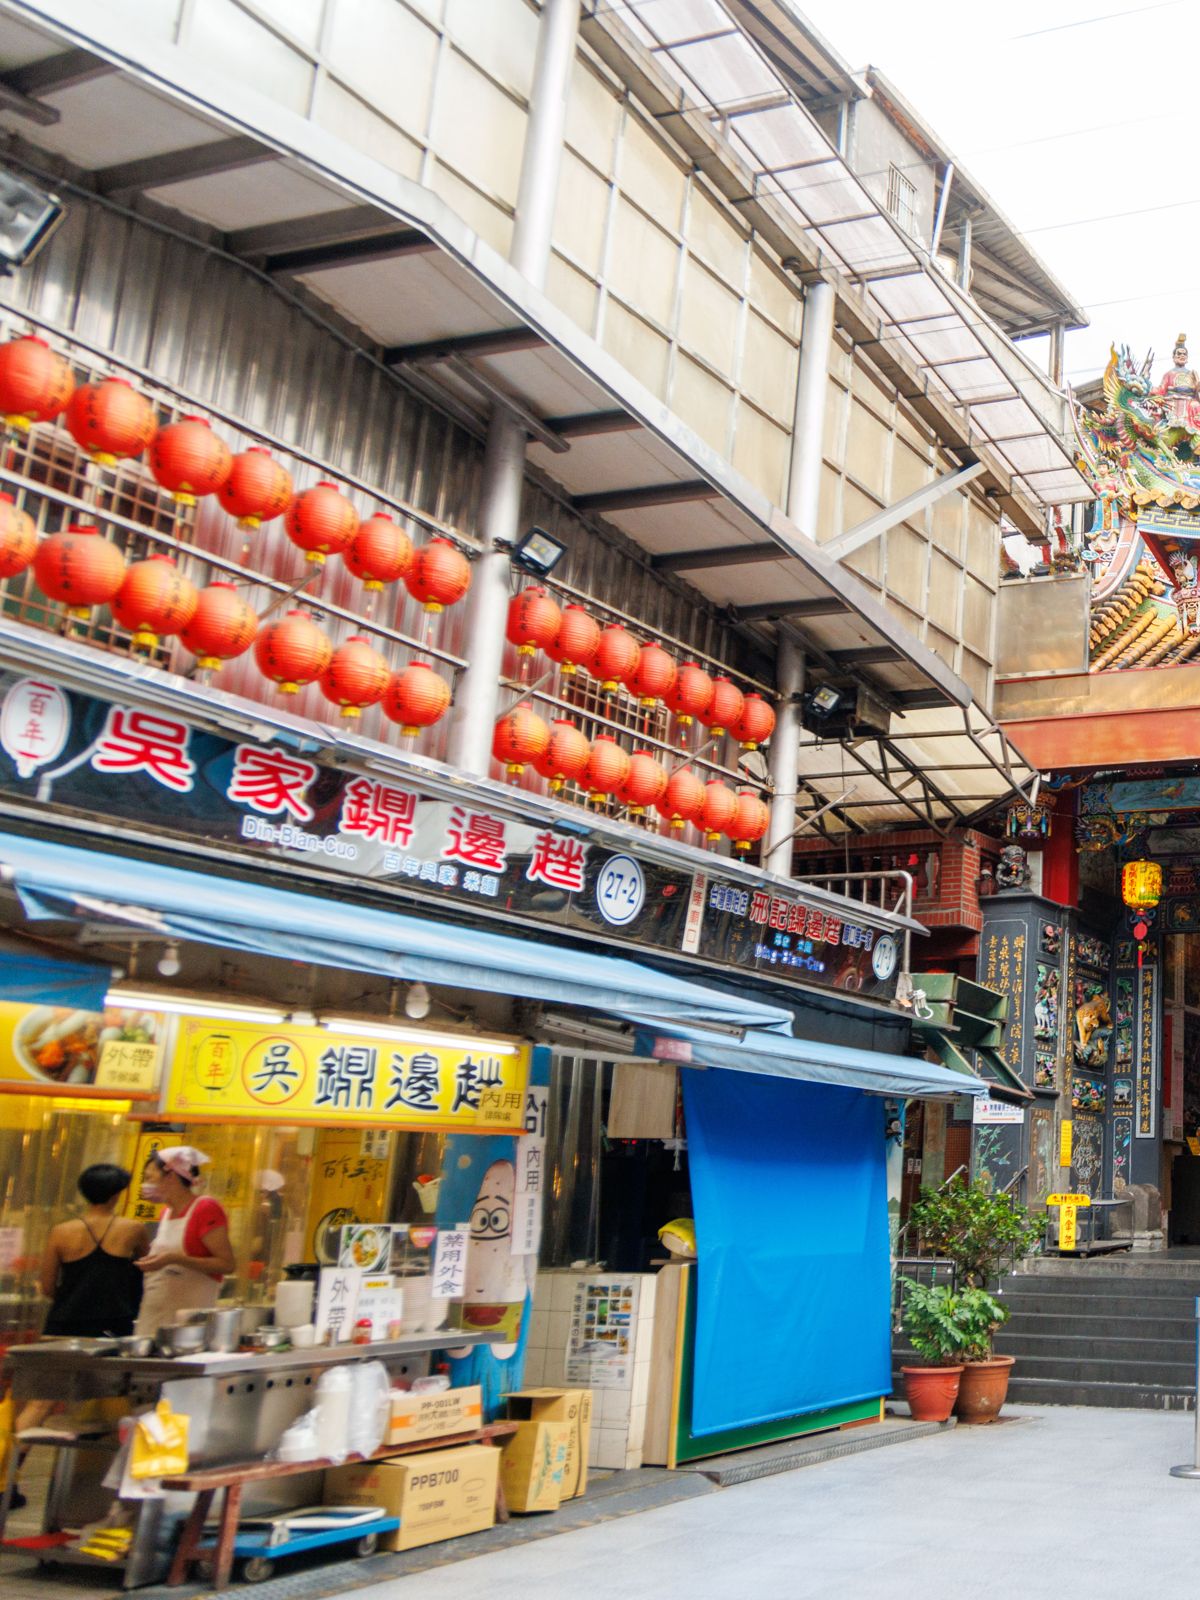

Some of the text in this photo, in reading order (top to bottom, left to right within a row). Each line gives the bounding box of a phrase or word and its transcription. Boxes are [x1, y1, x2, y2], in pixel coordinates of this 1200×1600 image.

[19, 691, 52, 749] 百年
[242, 815, 357, 859] Din-Bian-Cuo
[604, 872, 638, 909] 27-2
[105, 1046, 153, 1068] 外帶
[207, 1040, 229, 1085] 百年
[525, 1147, 540, 1192] 內用
[435, 1233, 465, 1295] 禁用外食
[410, 1468, 460, 1492] PPB700
